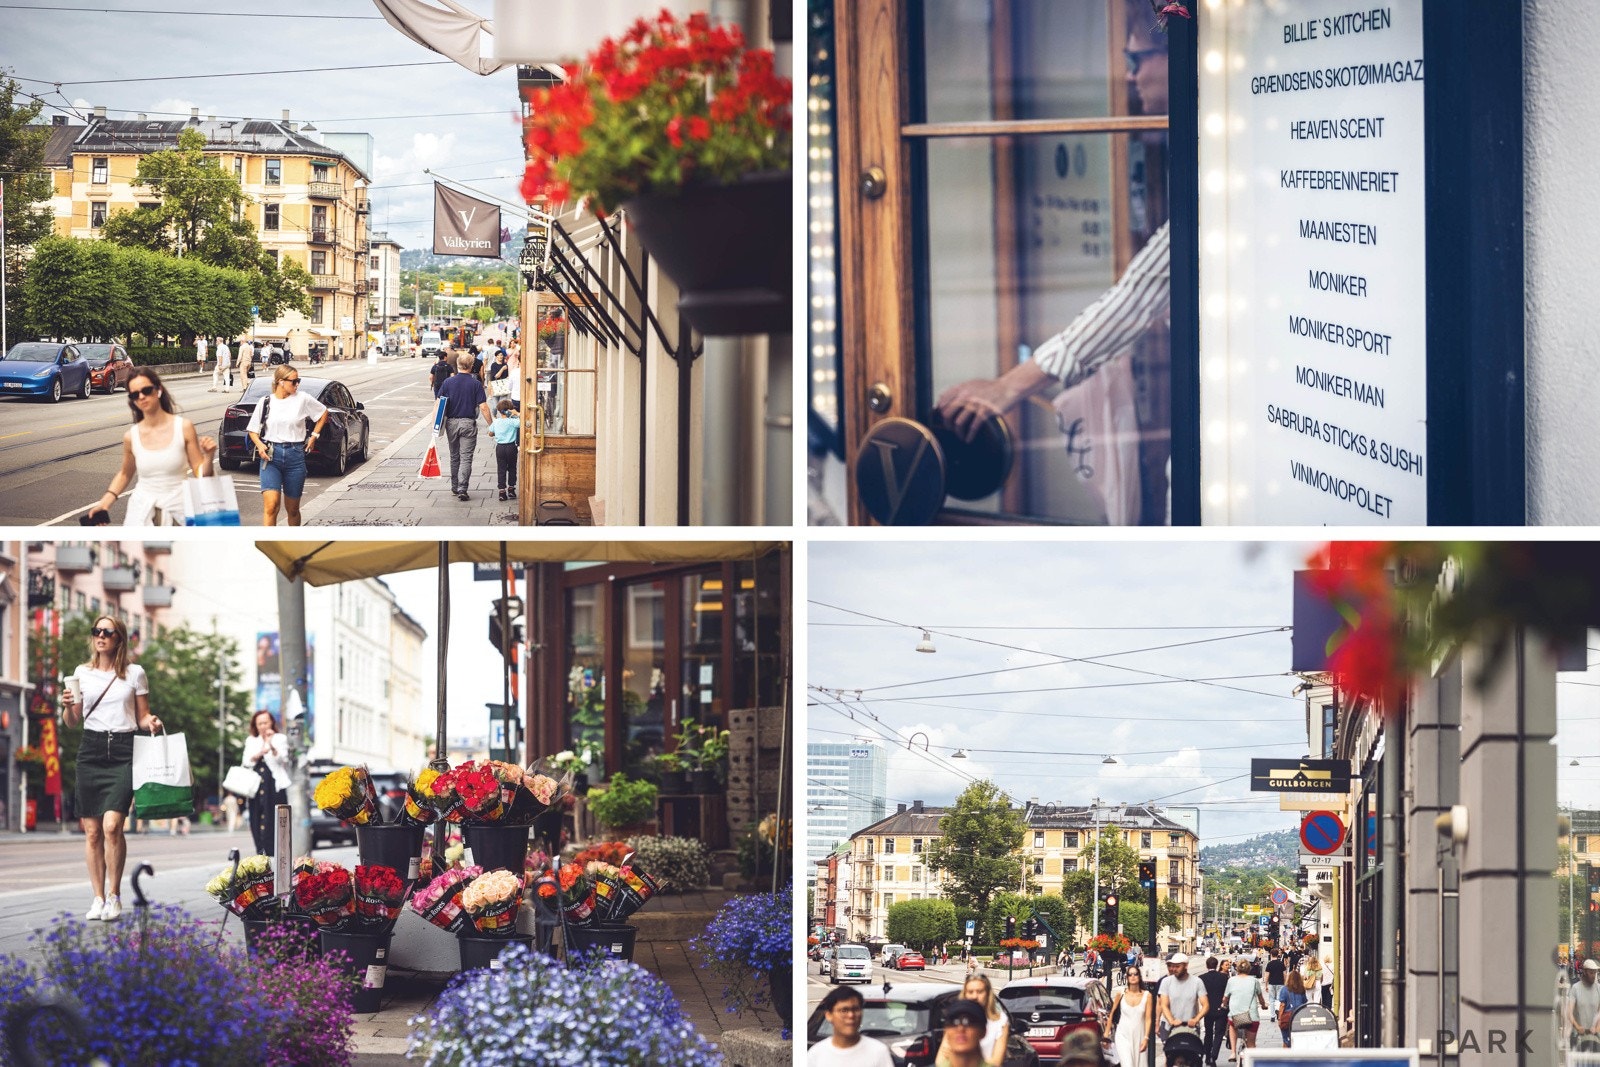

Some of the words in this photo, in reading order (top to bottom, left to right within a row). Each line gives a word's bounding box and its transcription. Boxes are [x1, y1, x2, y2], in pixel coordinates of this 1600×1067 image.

[1333, 7, 1391, 36] KITCHEN
[1251, 70, 1323, 95] GRÆNDSENS
[1324, 59, 1424, 89] SKOTØIMAGAZ
[1291, 119, 1338, 140] HEAVEN
[1339, 117, 1385, 139] SCENT
[1280, 169, 1399, 193] KAFFEBRENNERIET
[442, 236, 492, 251] Valkyrien
[1299, 219, 1377, 246] MAANESTEN
[1309, 269, 1367, 298] MONIKER
[1289, 314, 1344, 346] MONIKER
[1346, 326, 1392, 356] SPORT
[1296, 364, 1352, 399] MONIKER
[1354, 380, 1384, 409] MAN
[1267, 404, 1322, 440] SABRURA
[1322, 422, 1367, 456] STICKS
[1369, 439, 1378, 461] &
[1380, 442, 1423, 477] SUSHI
[1290, 459, 1393, 519] VINMONOPOLET
[1269, 779, 1332, 788] GULLBORGEN
